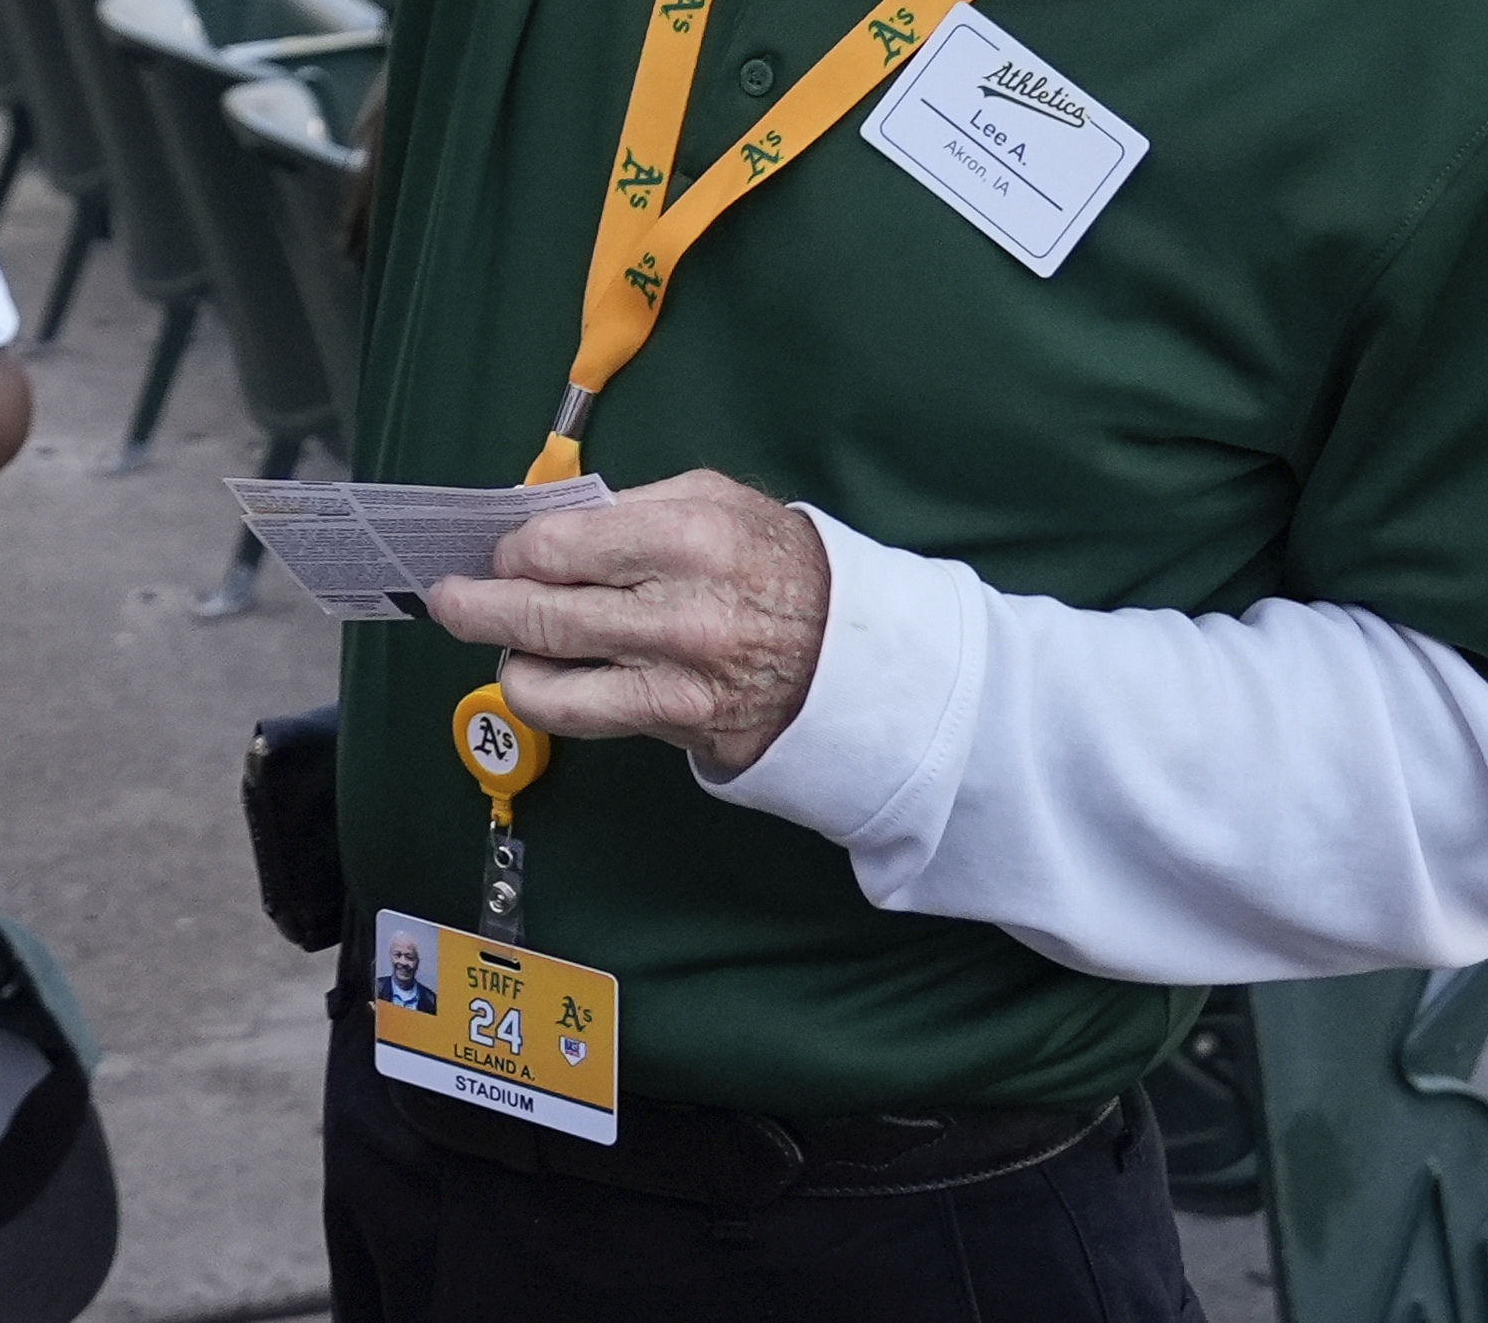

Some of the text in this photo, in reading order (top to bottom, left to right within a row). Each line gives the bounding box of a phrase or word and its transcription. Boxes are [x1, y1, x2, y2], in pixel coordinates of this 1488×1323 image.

[868, 6, 921, 69] A's
[978, 60, 1088, 129] Athletics
[741, 129, 783, 184] A's
[942, 139, 987, 183] Akron,
[969, 109, 1028, 167] Lee A.
[617, 147, 664, 210] A's
[624, 251, 664, 311] A's
[473, 716, 513, 761] A's
[467, 965, 525, 1000] STAFF
[468, 996, 524, 1056] 24
[555, 995, 593, 1033] A's
[453, 1042, 536, 1081] LELAND A.
[455, 1075, 535, 1113] STADIUM
